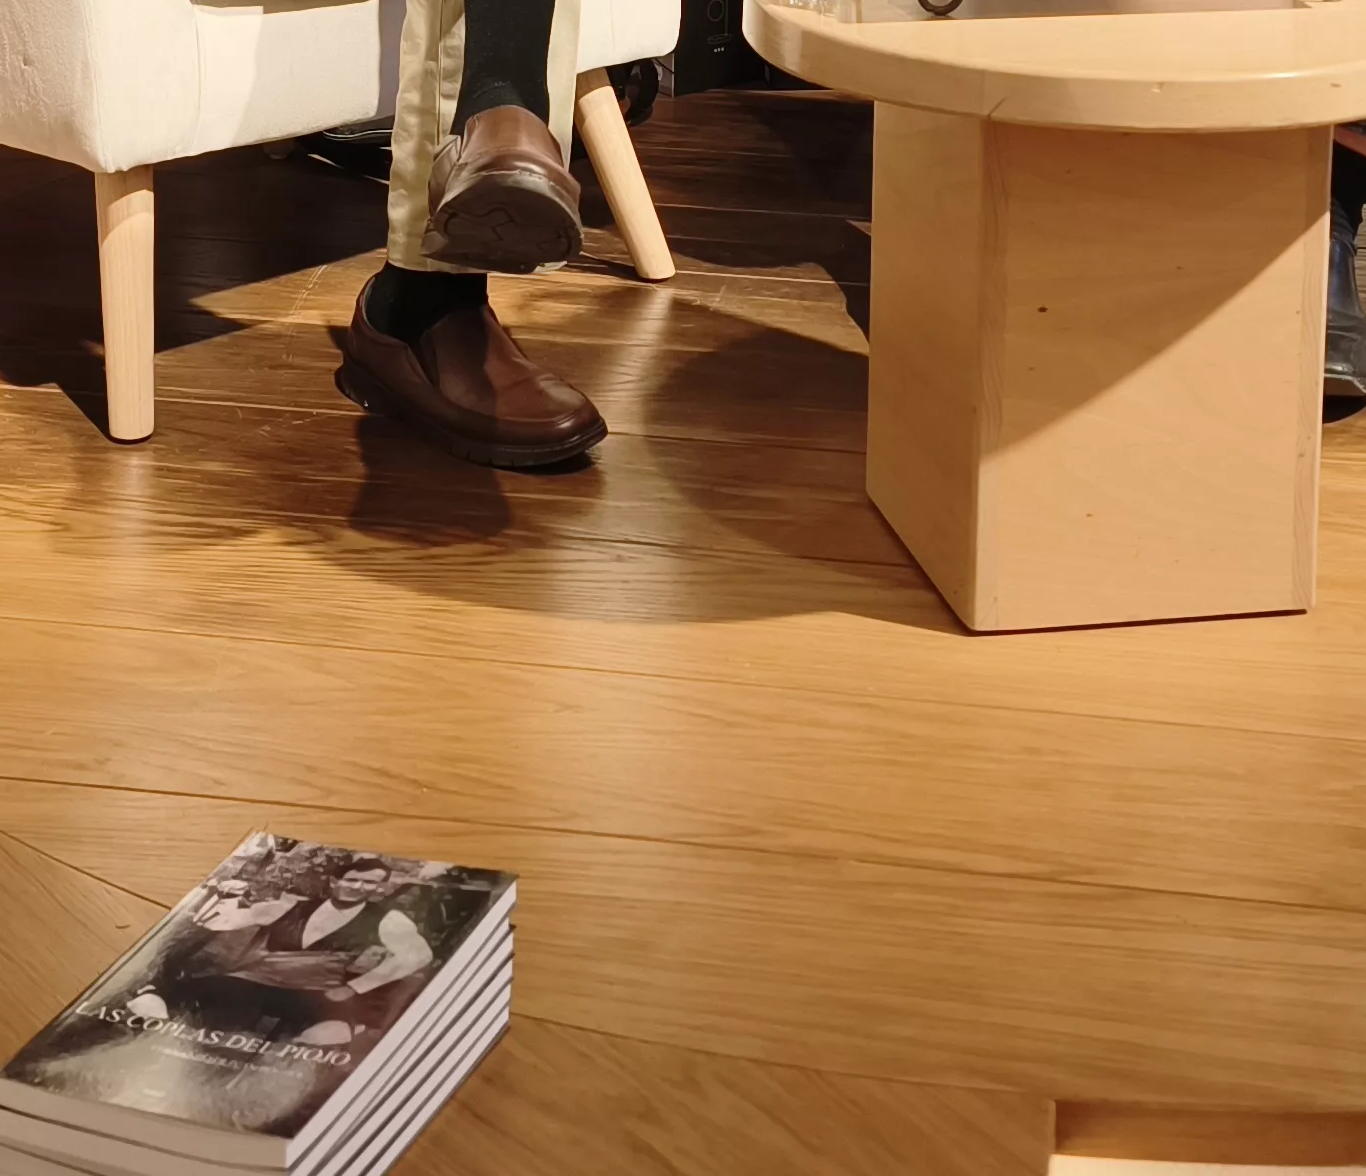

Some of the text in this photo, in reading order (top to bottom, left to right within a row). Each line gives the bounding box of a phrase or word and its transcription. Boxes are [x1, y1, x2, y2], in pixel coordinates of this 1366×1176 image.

[76, 1001, 125, 1023] LAS
[126, 1014, 225, 1046] COPLAS
[225, 1034, 275, 1055] DEL
[275, 1043, 352, 1067] PIOJO
